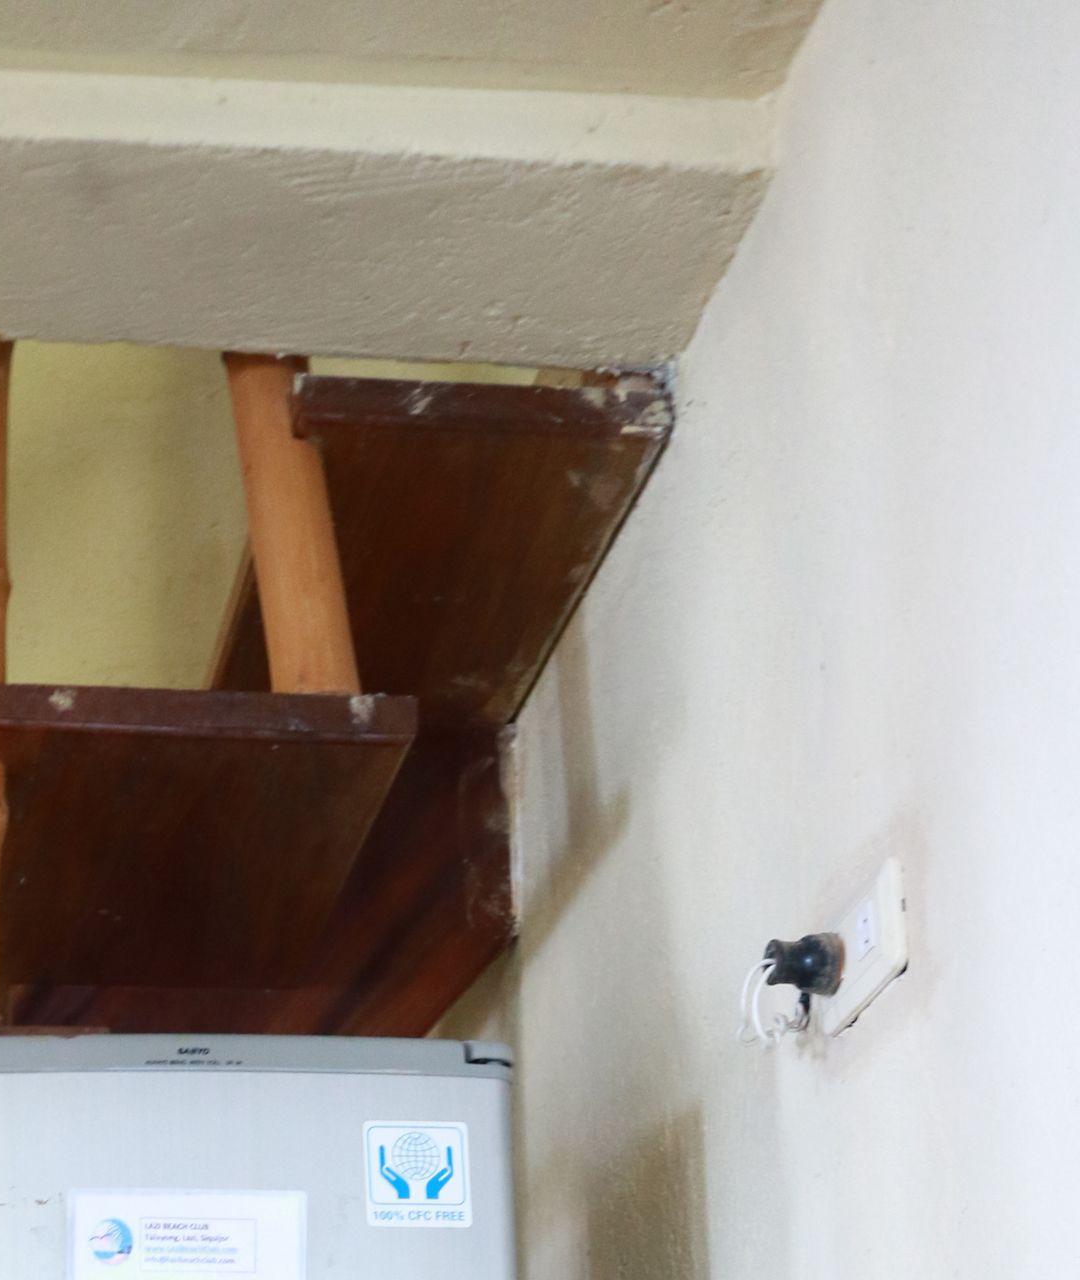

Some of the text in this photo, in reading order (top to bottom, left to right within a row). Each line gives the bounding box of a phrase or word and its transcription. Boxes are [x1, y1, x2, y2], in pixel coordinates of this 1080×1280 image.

[373, 1210, 465, 1221] 100% CFC FREE
